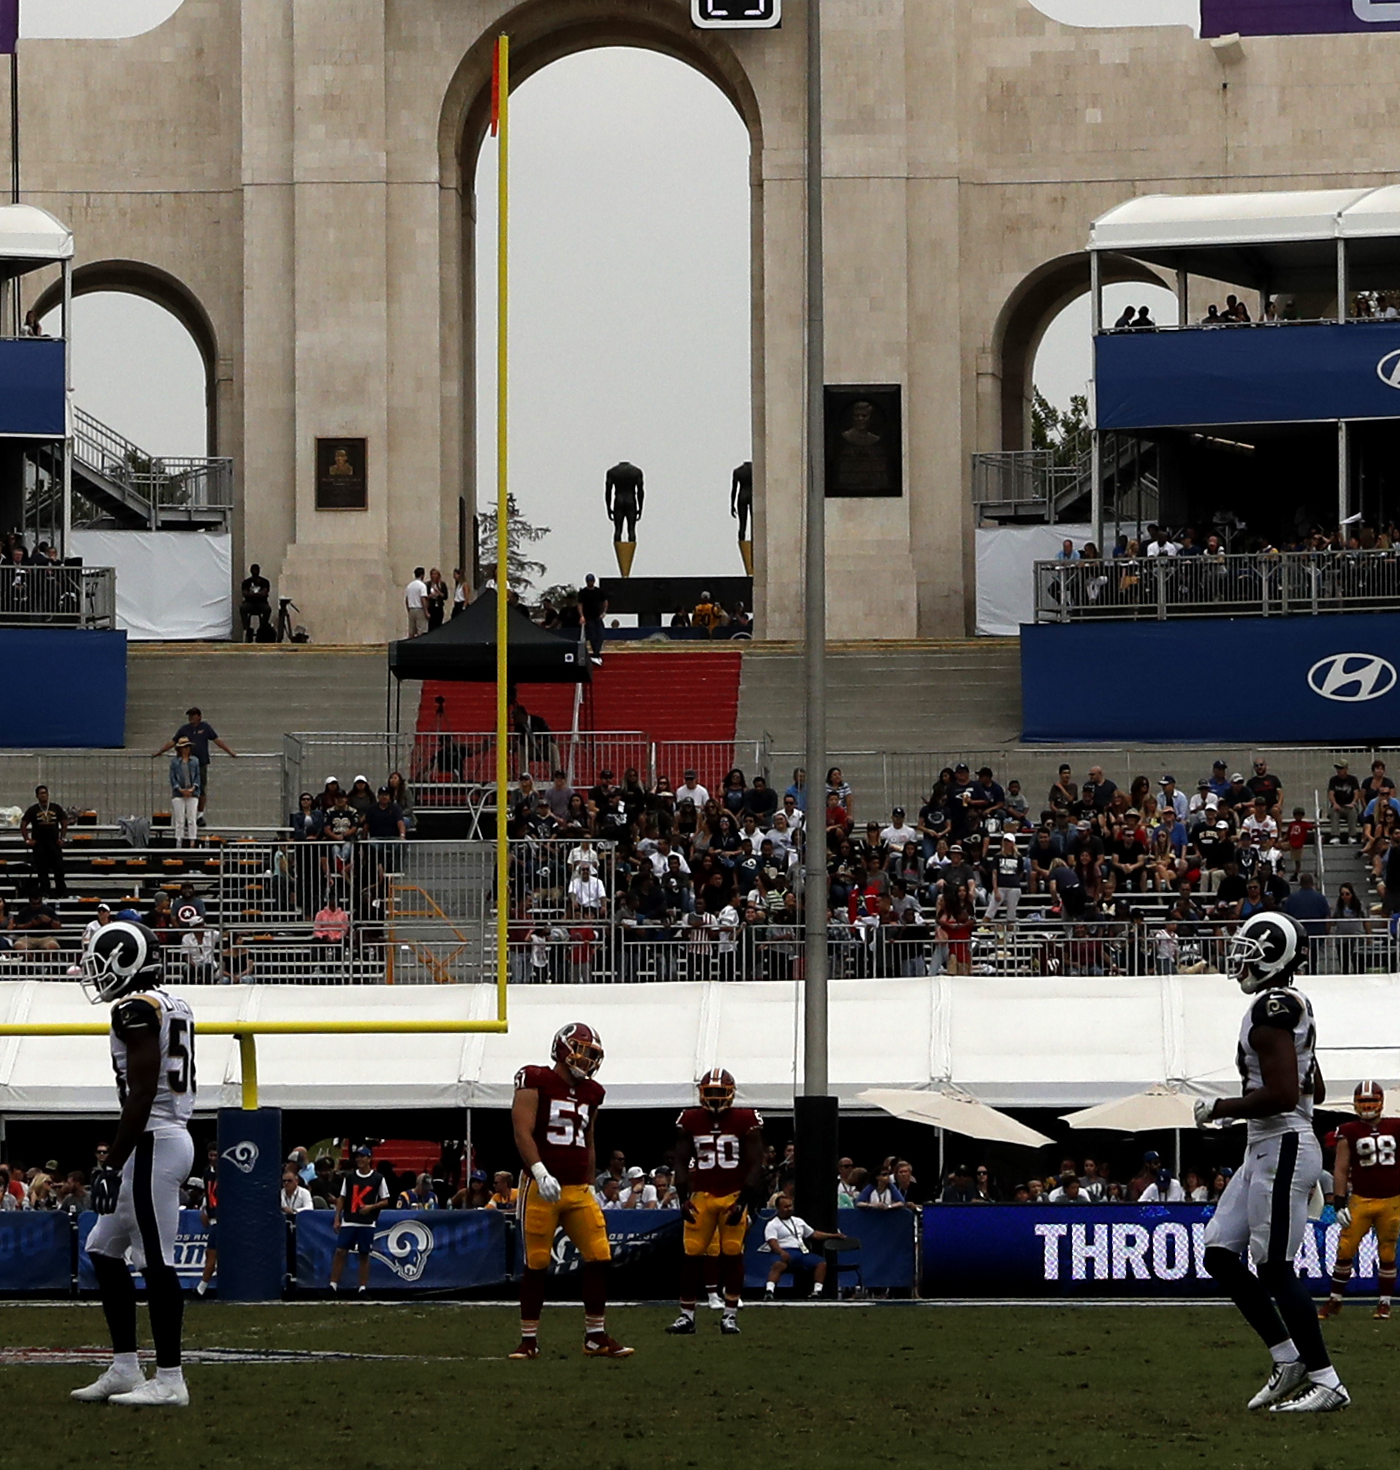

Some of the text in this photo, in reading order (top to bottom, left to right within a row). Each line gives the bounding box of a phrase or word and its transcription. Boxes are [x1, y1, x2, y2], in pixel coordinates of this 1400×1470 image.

[546, 1098, 591, 1149] 51
[692, 1133, 741, 1170] 50
[1355, 1134, 1397, 1168] 98
[350, 1184, 374, 1214] K
